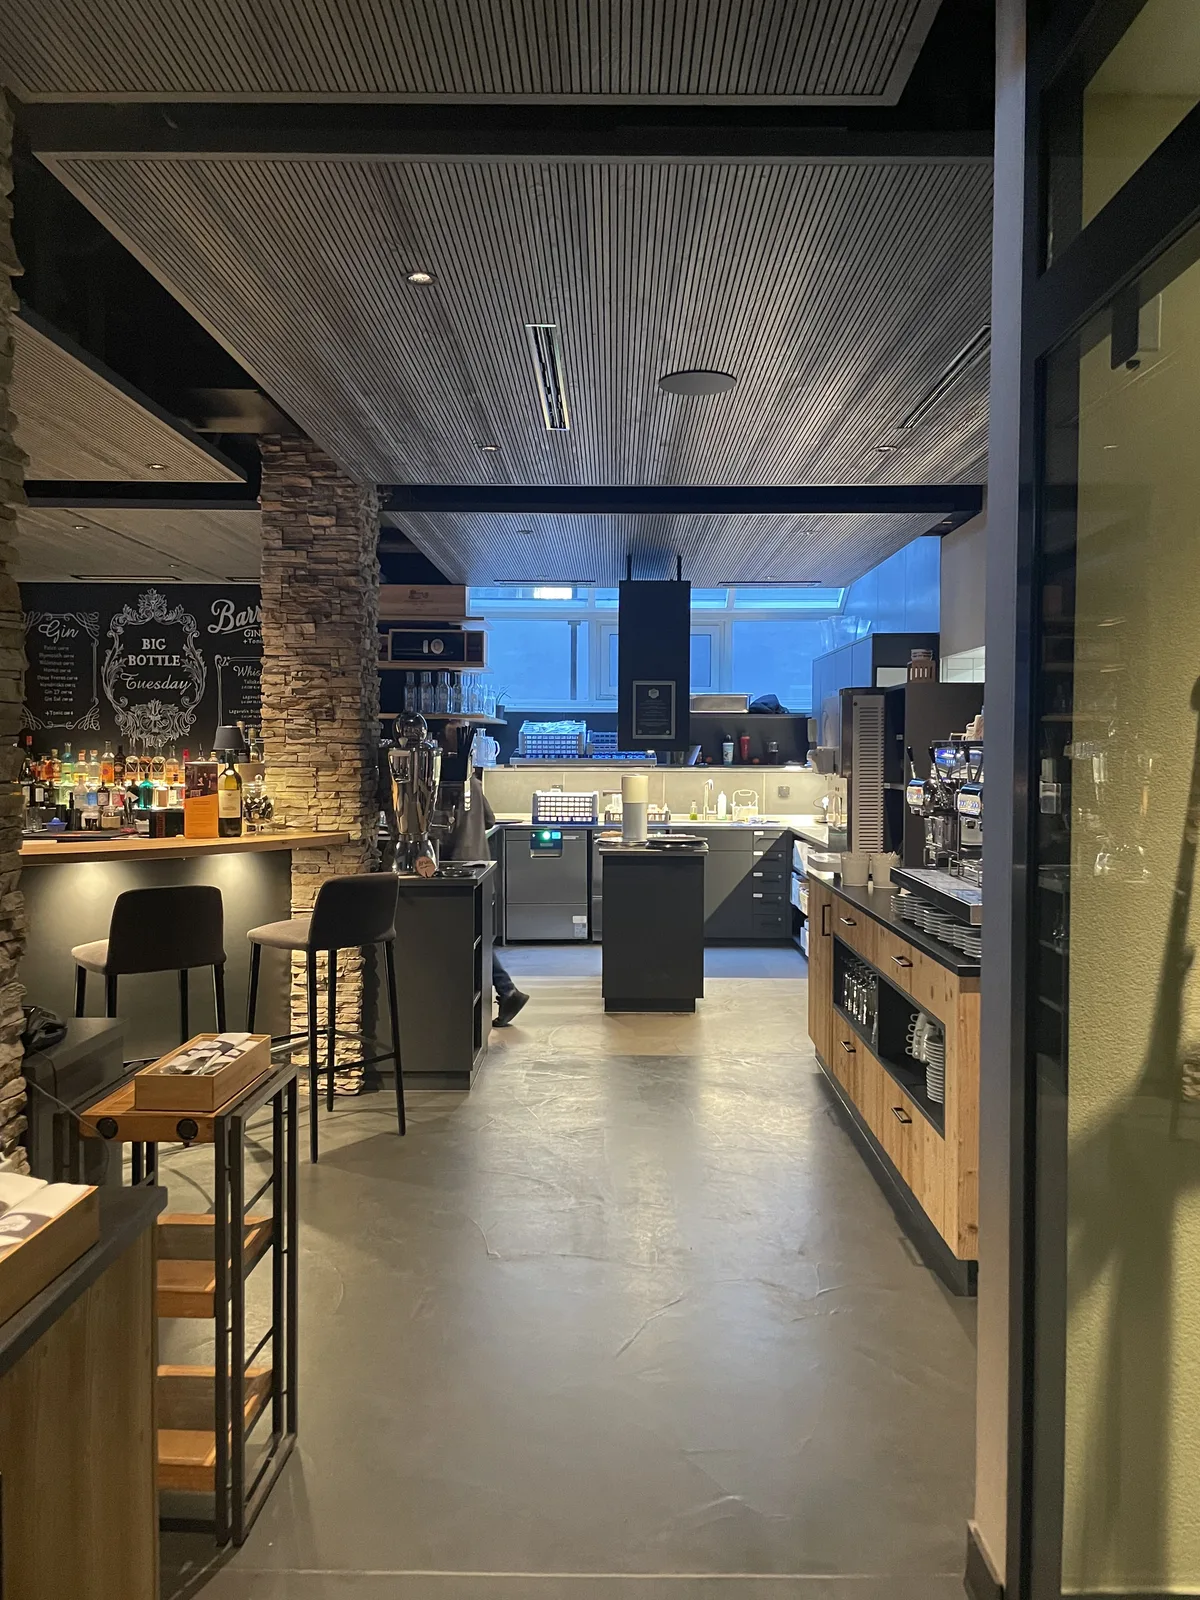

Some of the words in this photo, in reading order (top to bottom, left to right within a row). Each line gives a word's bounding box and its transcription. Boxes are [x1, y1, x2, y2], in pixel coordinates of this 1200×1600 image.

[38, 619, 79, 643] Gin
[243, 628, 261, 638] GIN
[141, 638, 167, 650] BIG
[127, 654, 181, 667] BOTTLE
[233, 665, 261, 677] Whis
[120, 672, 192, 695] Tuesday
